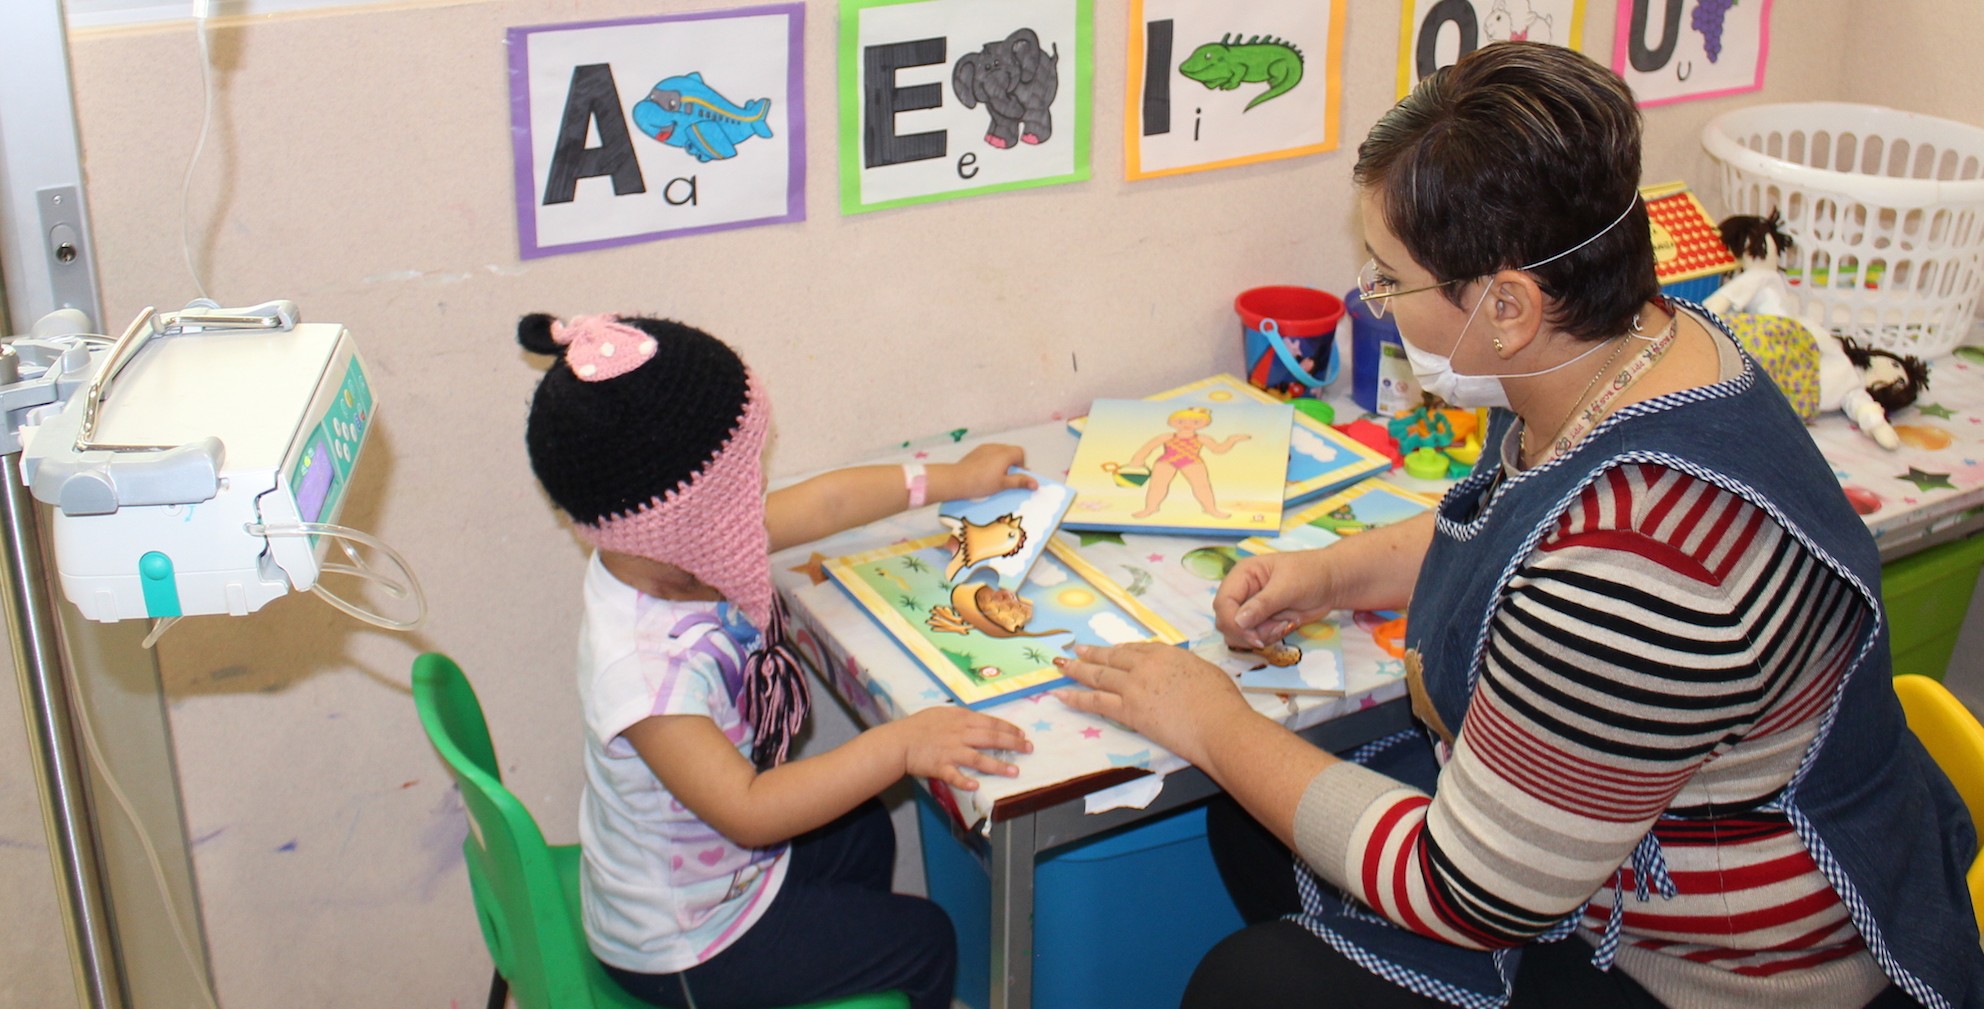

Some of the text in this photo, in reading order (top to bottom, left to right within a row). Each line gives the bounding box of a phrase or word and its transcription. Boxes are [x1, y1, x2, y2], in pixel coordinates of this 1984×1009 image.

[1416, 0, 1479, 83] O
[1628, 0, 1683, 73] U
[864, 36, 947, 170] E
[1142, 18, 1174, 137] I
[542, 62, 646, 206] A
[1193, 107, 1203, 142] i
[662, 174, 698, 207] a
[956, 151, 980, 180] e
